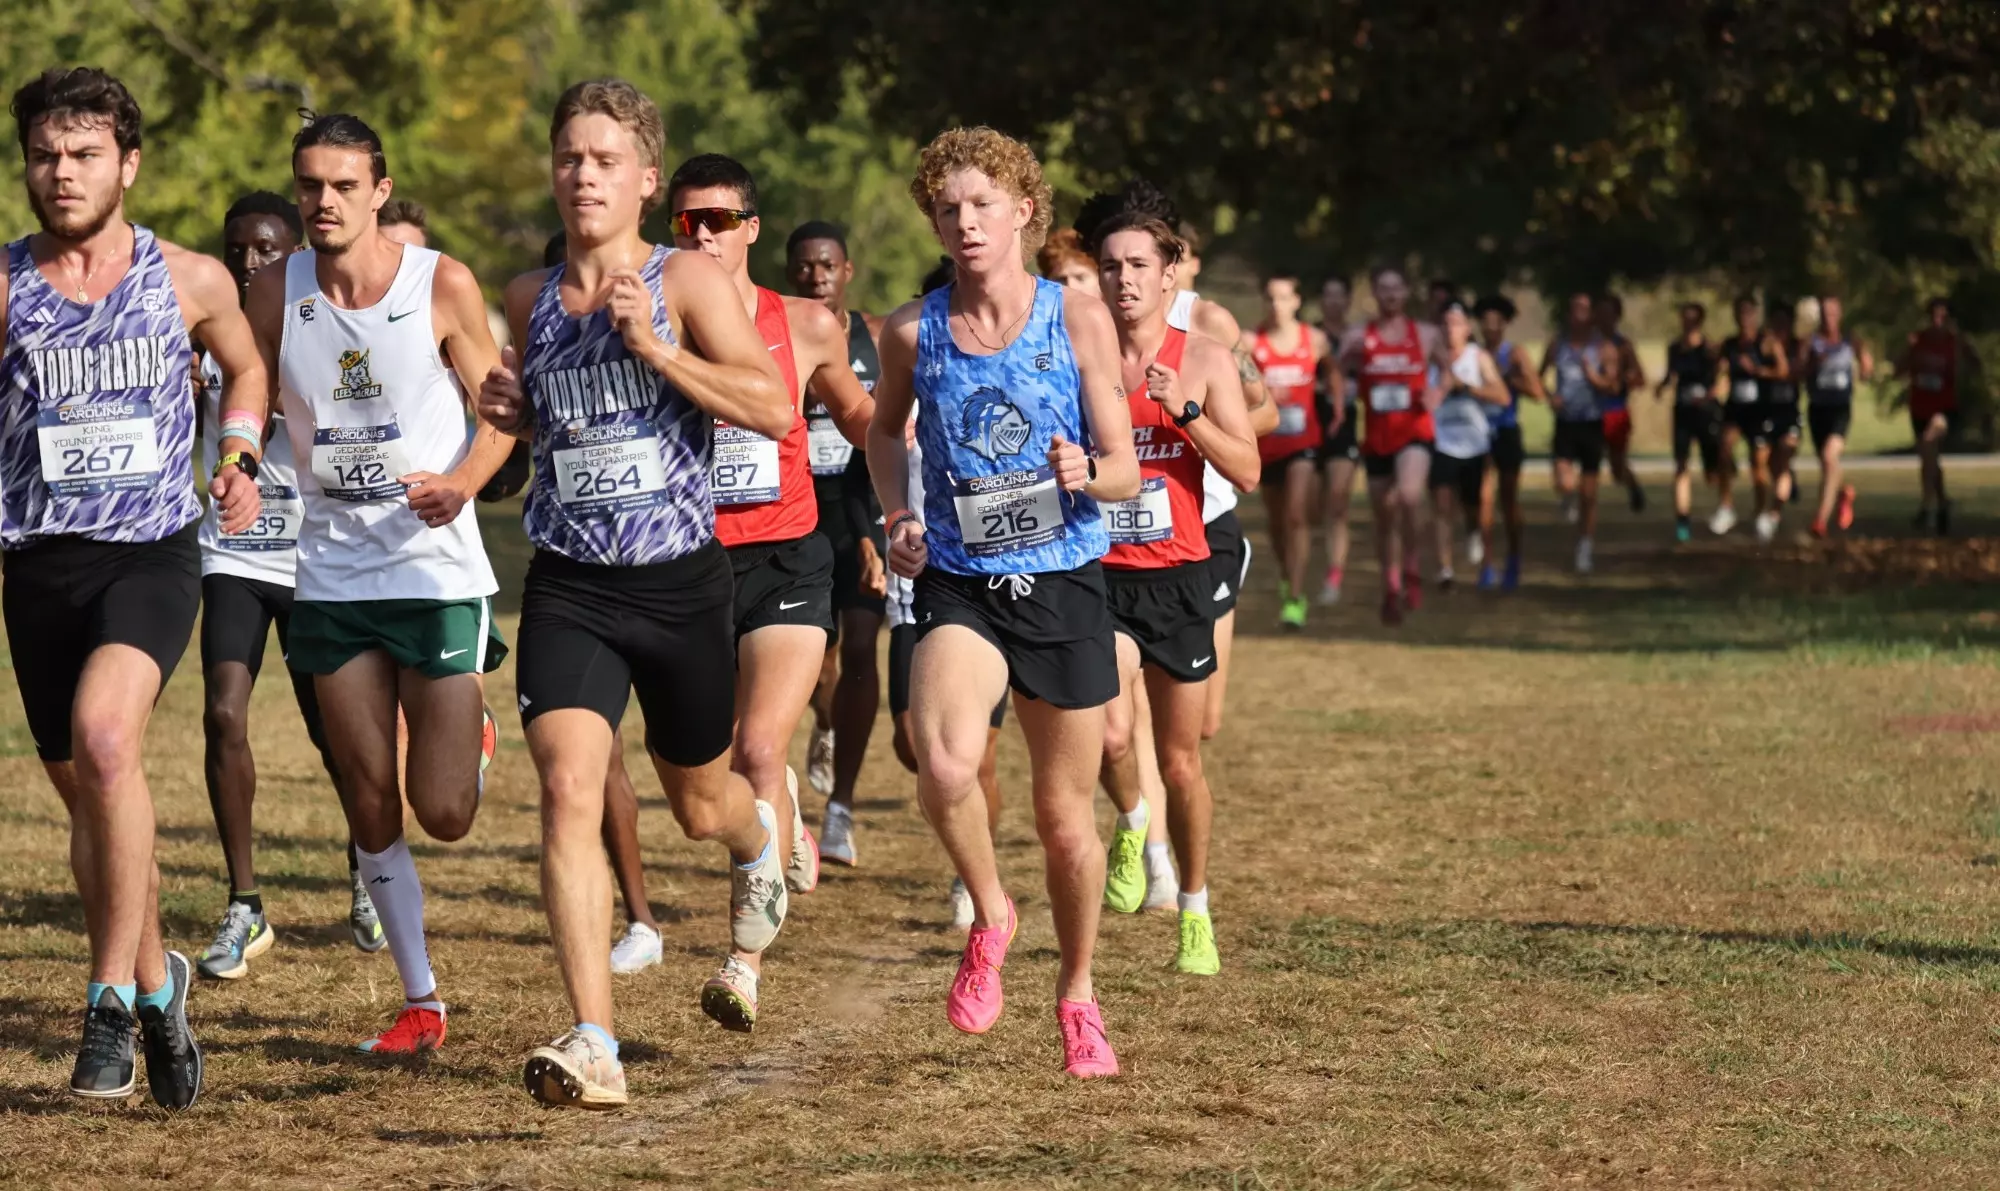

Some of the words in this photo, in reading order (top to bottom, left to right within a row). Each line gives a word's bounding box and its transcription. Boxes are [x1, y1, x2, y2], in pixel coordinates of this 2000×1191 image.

[32, 346, 94, 401] YOUNG
[98, 335, 167, 392] HARRIS
[538, 367, 593, 422] YOUNG
[590, 357, 658, 415] HARRIS
[59, 404, 135, 422] CAROLINAS
[73, 402, 122, 411] CONFERENCE
[82, 424, 111, 435] KING
[329, 429, 386, 442] CAROLINAS
[568, 425, 638, 446] CAROLINAS
[580, 422, 625, 434] CONFERENCE
[52, 436, 93, 448] YOUNG
[98, 431, 143, 443] HARRIS
[334, 445, 378, 454] GECKLER
[581, 445, 624, 458] FIGGINS
[62, 444, 134, 476] 267
[564, 459, 600, 471] YOUNG
[604, 451, 648, 466] HARRIS
[333, 462, 387, 487] 142
[573, 464, 641, 498] 264
[969, 472, 1039, 493] CAROLINAS
[982, 470, 1026, 481] CONFERENCE
[977, 496, 1037, 514] SOUTHERN
[988, 490, 1023, 503] JONES
[238, 517, 286, 536] 39
[981, 508, 1039, 539] 216
[1107, 510, 1154, 529] 180
